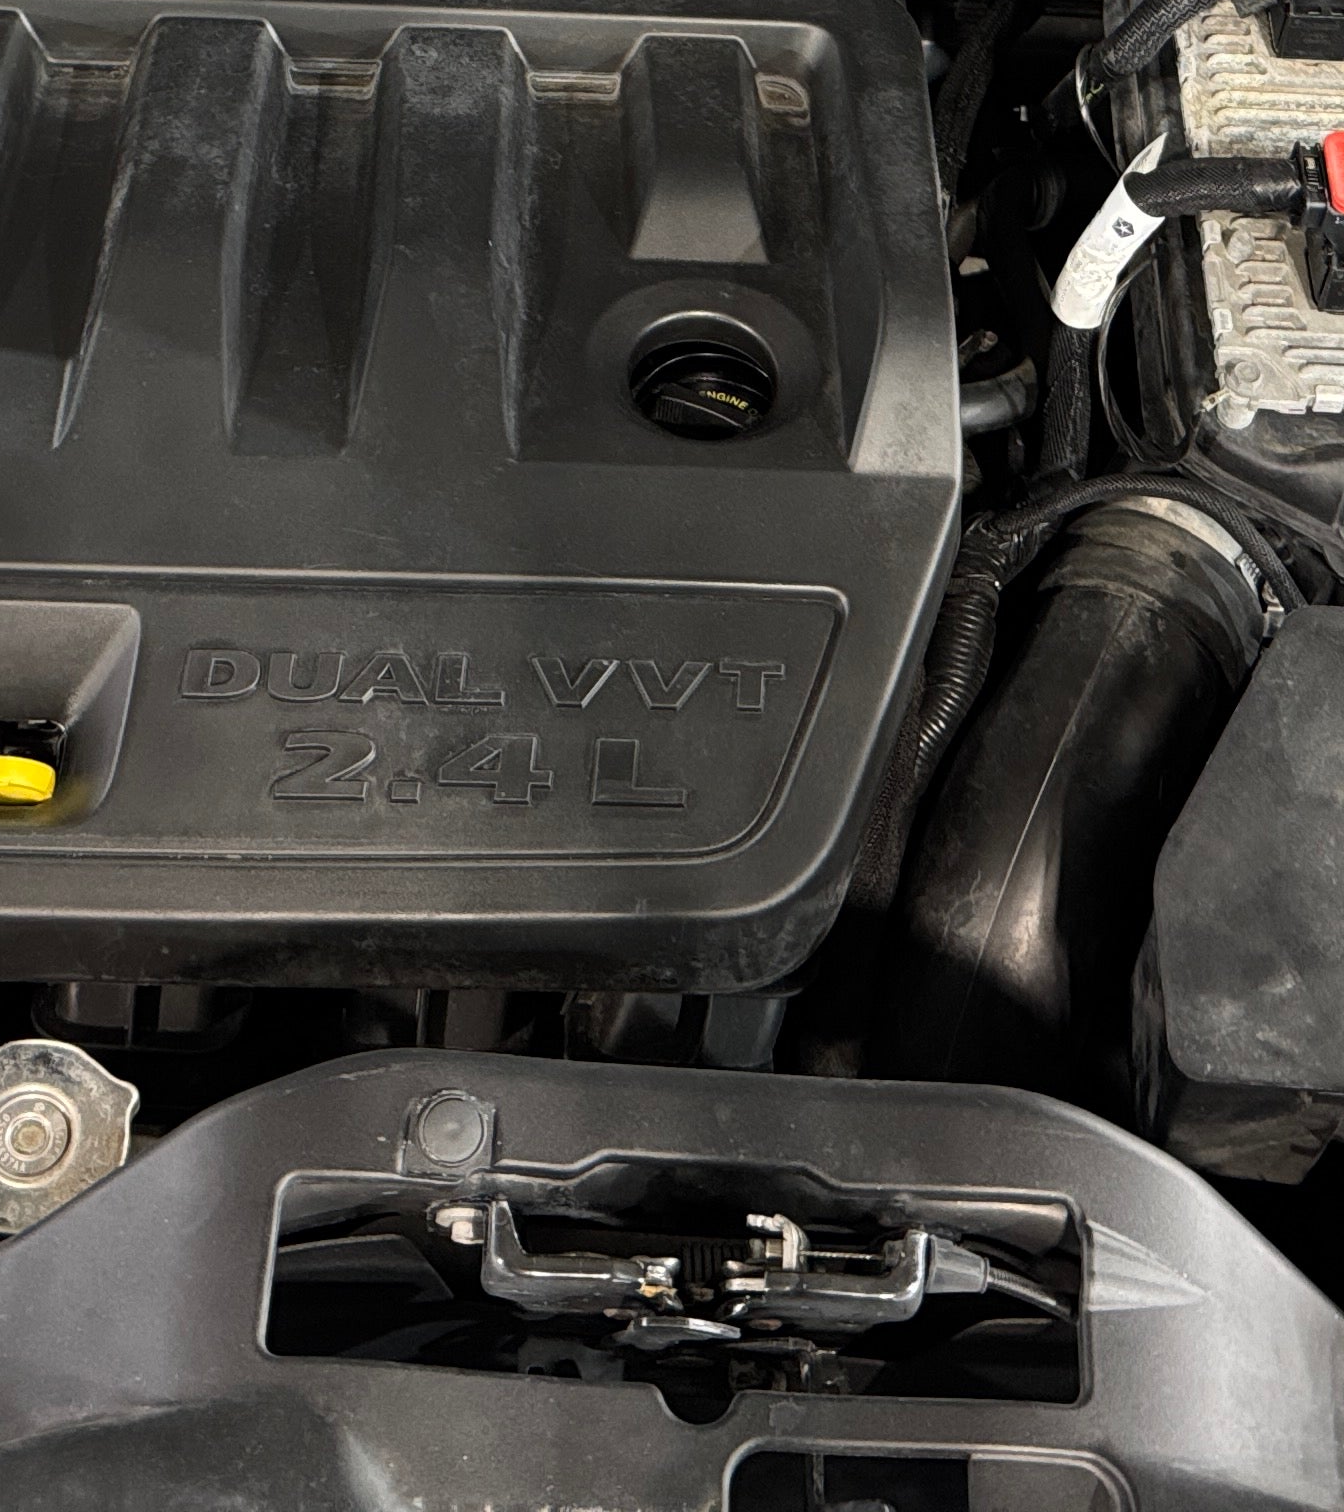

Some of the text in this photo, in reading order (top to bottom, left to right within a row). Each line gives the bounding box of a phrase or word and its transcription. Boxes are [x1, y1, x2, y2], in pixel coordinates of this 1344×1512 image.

[181, 646, 786, 713] DUAL VVT
[269, 728, 689, 808] 2.4 L
